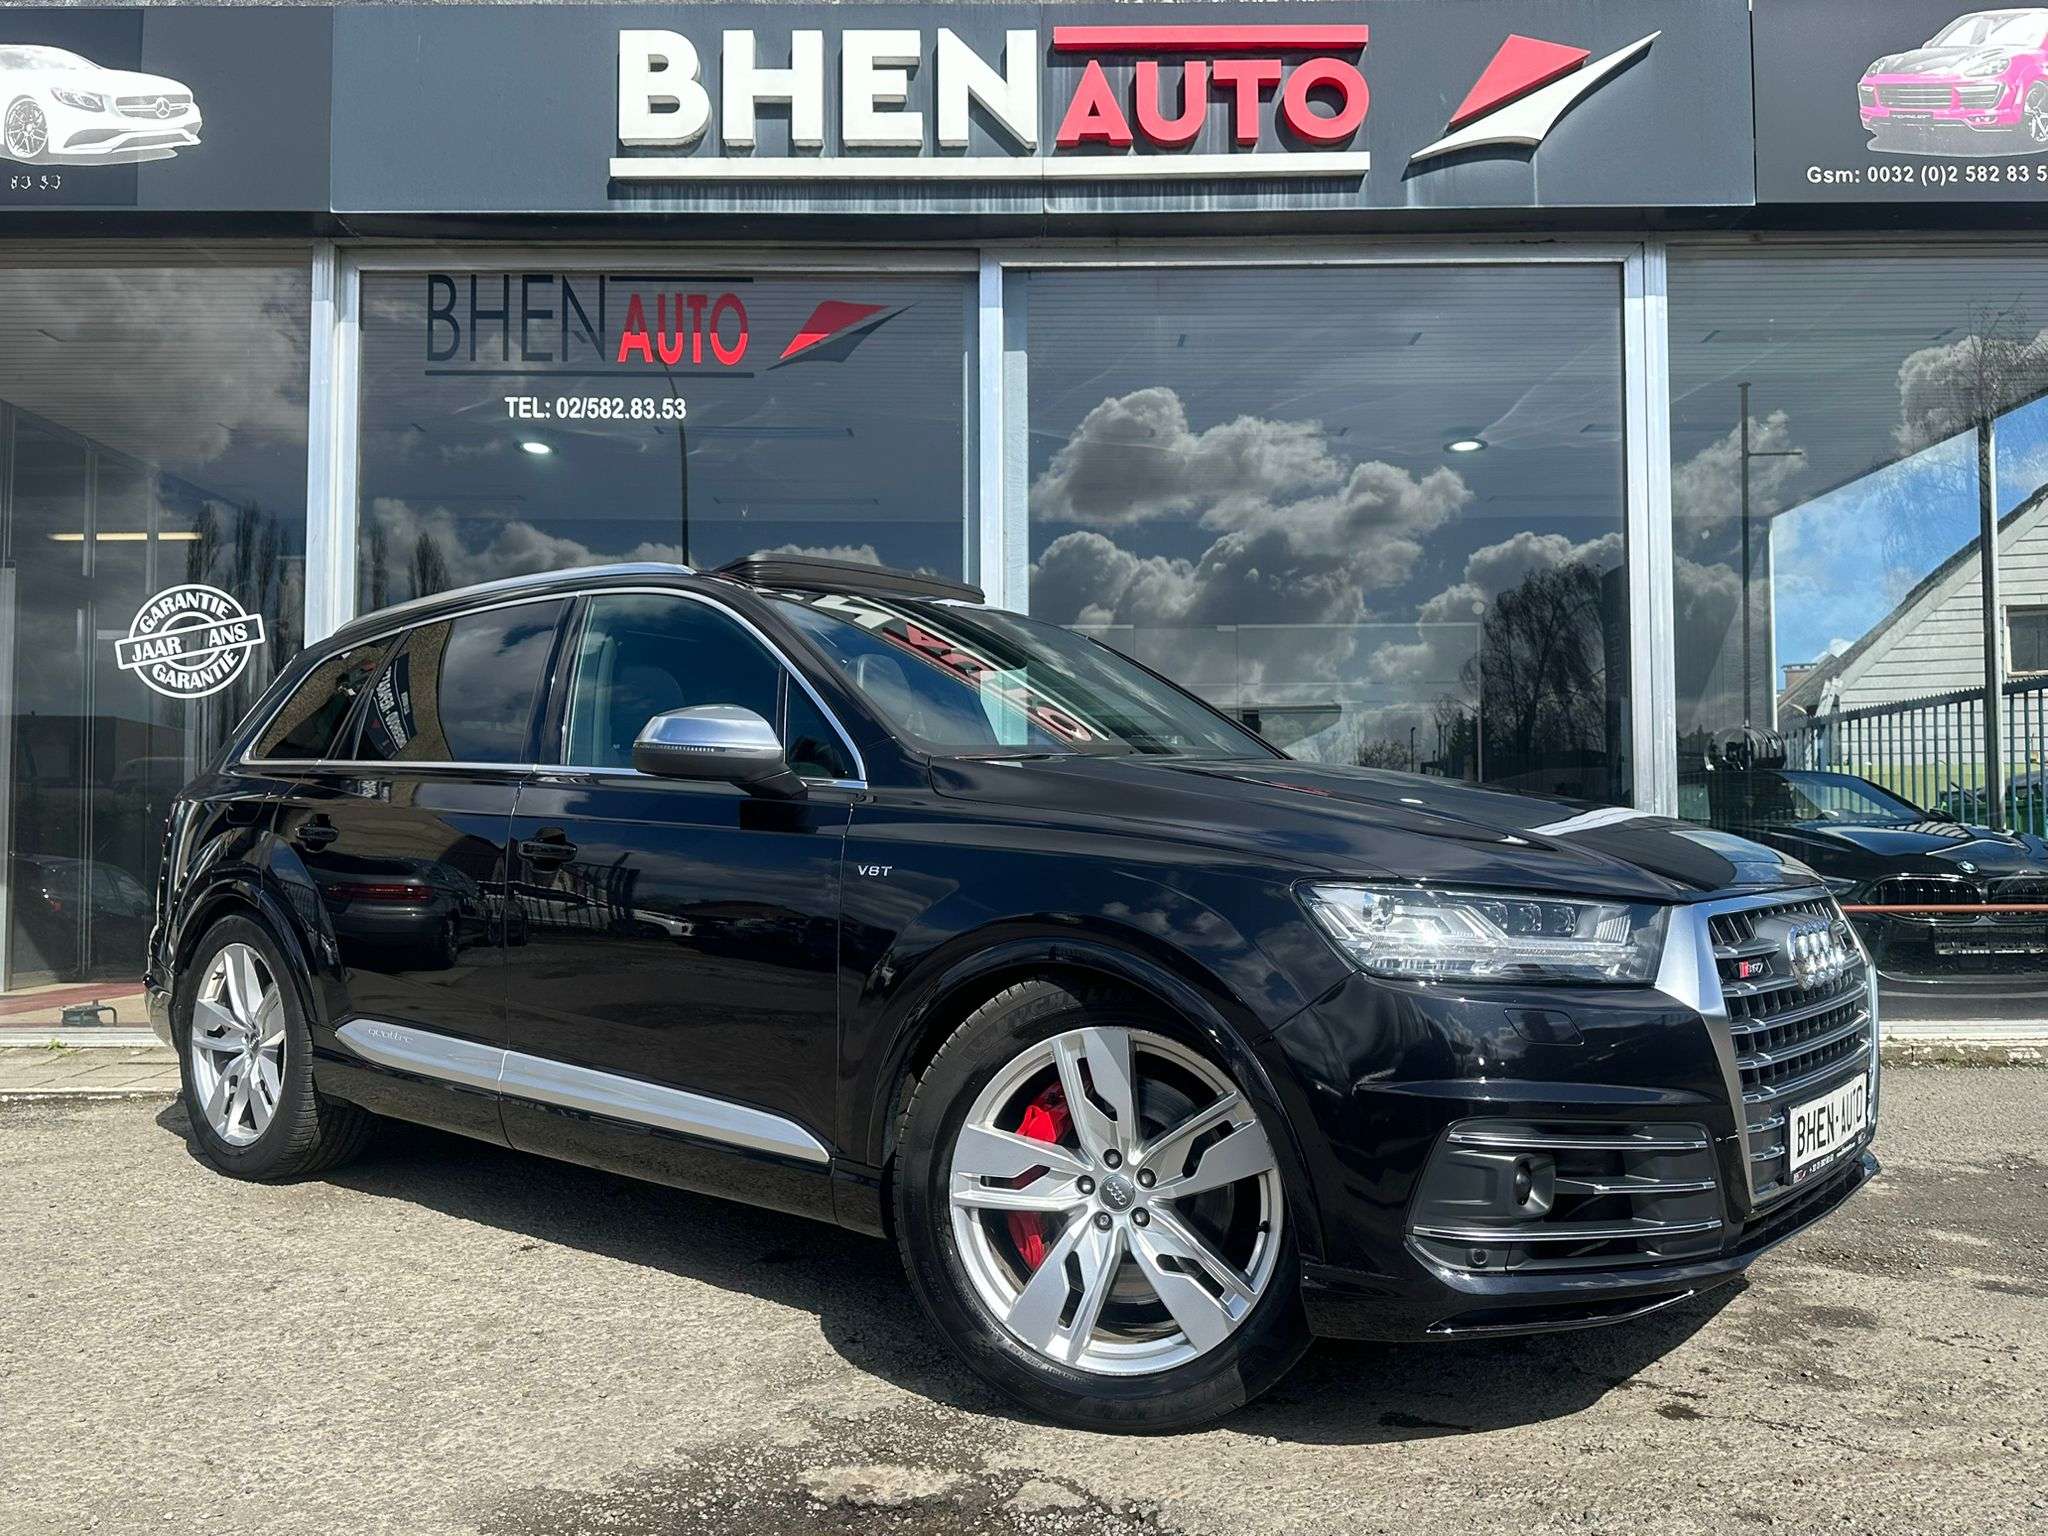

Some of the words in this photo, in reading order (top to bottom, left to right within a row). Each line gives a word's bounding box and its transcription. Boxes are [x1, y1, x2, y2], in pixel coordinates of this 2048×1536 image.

[618, 27, 1038, 150] BHEN
[1054, 56, 1370, 148] AUTO
[1806, 166, 1861, 184] Gsm:
[1867, 166, 1914, 183] 0032
[1920, 165, 1959, 187] (0)2
[1965, 165, 2000, 183] 582
[2006, 165, 2031, 183] 83
[426, 273, 606, 362] BHEN
[616, 291, 749, 366] AUTO
[504, 396, 551, 418] TEL:
[556, 396, 687, 420] 02/582.83.53
[139, 590, 233, 634] GARANTIE
[131, 635, 183, 663] JAAR
[208, 622, 249, 648] ANS
[151, 648, 240, 690] GARANTIE
[857, 864, 893, 877] V8T
